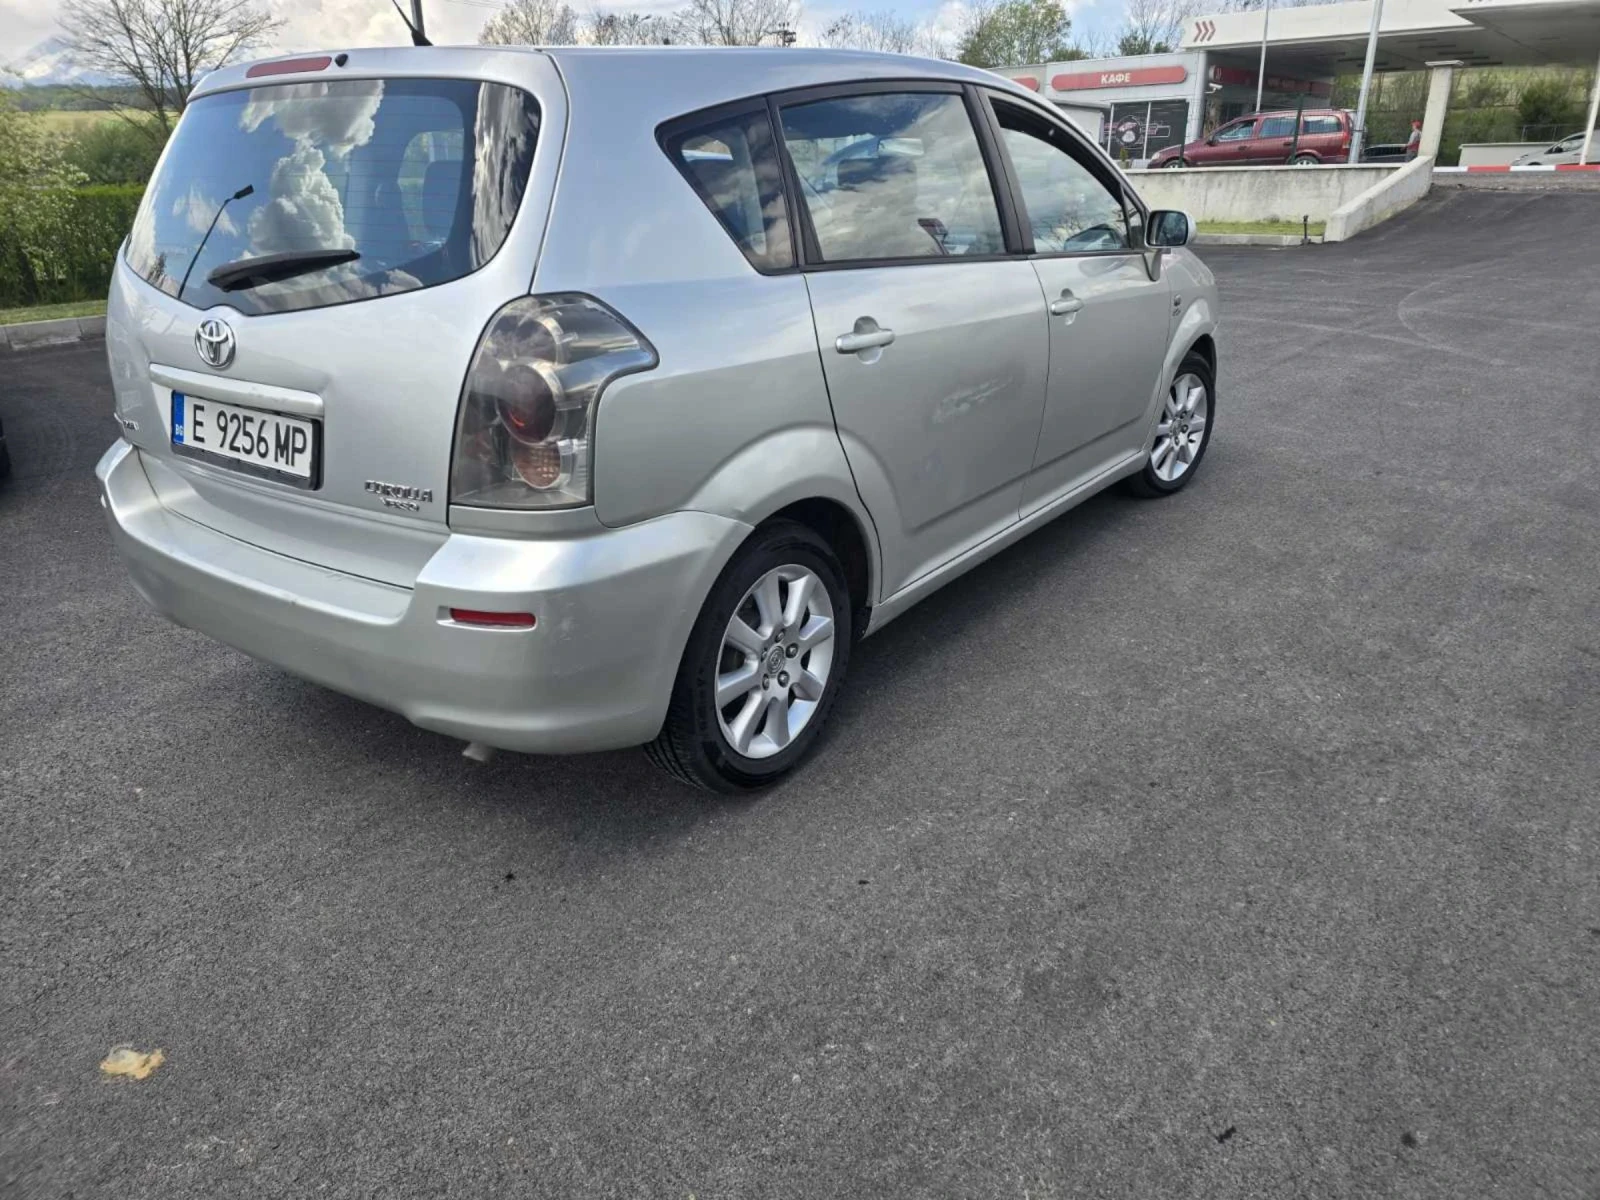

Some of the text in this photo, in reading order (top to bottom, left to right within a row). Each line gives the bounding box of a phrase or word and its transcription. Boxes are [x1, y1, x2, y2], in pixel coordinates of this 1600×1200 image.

[1101, 73, 1131, 84] КАФЕ
[175, 424, 184, 436] BG
[193, 403, 307, 467] E 9256 MP
